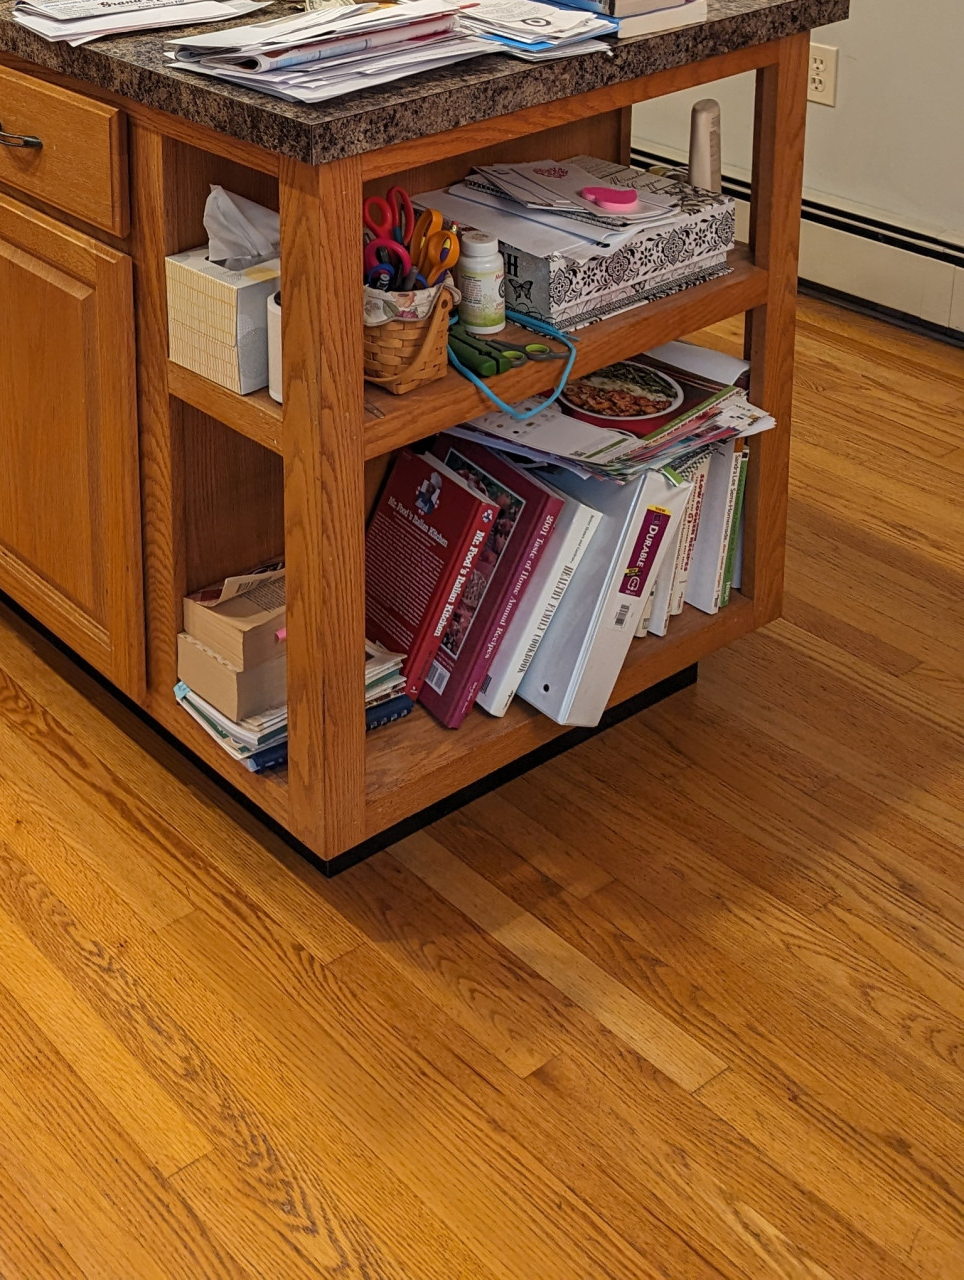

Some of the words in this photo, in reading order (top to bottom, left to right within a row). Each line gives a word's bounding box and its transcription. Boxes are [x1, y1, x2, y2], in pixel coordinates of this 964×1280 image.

[695, 473, 705, 499] SLOW
[541, 514, 554, 536] 2001
[689, 499, 701, 535] COOKER
[426, 526, 451, 547] Kitchen
[472, 529, 485, 546] Mr.
[530, 536, 544, 559] Taste
[636, 524, 658, 568] DURABLE
[524, 559, 533, 571] of
[449, 574, 466, 604] Italian
[513, 570, 529, 595] Home
[551, 564, 573, 601] HEALTHY
[434, 603, 454, 638] Kitchen
[500, 595, 517, 626] Annual
[537, 602, 555, 632] FAMILY
[484, 626, 503, 659] Recipes
[517, 632, 541, 675] COOKBOOK
